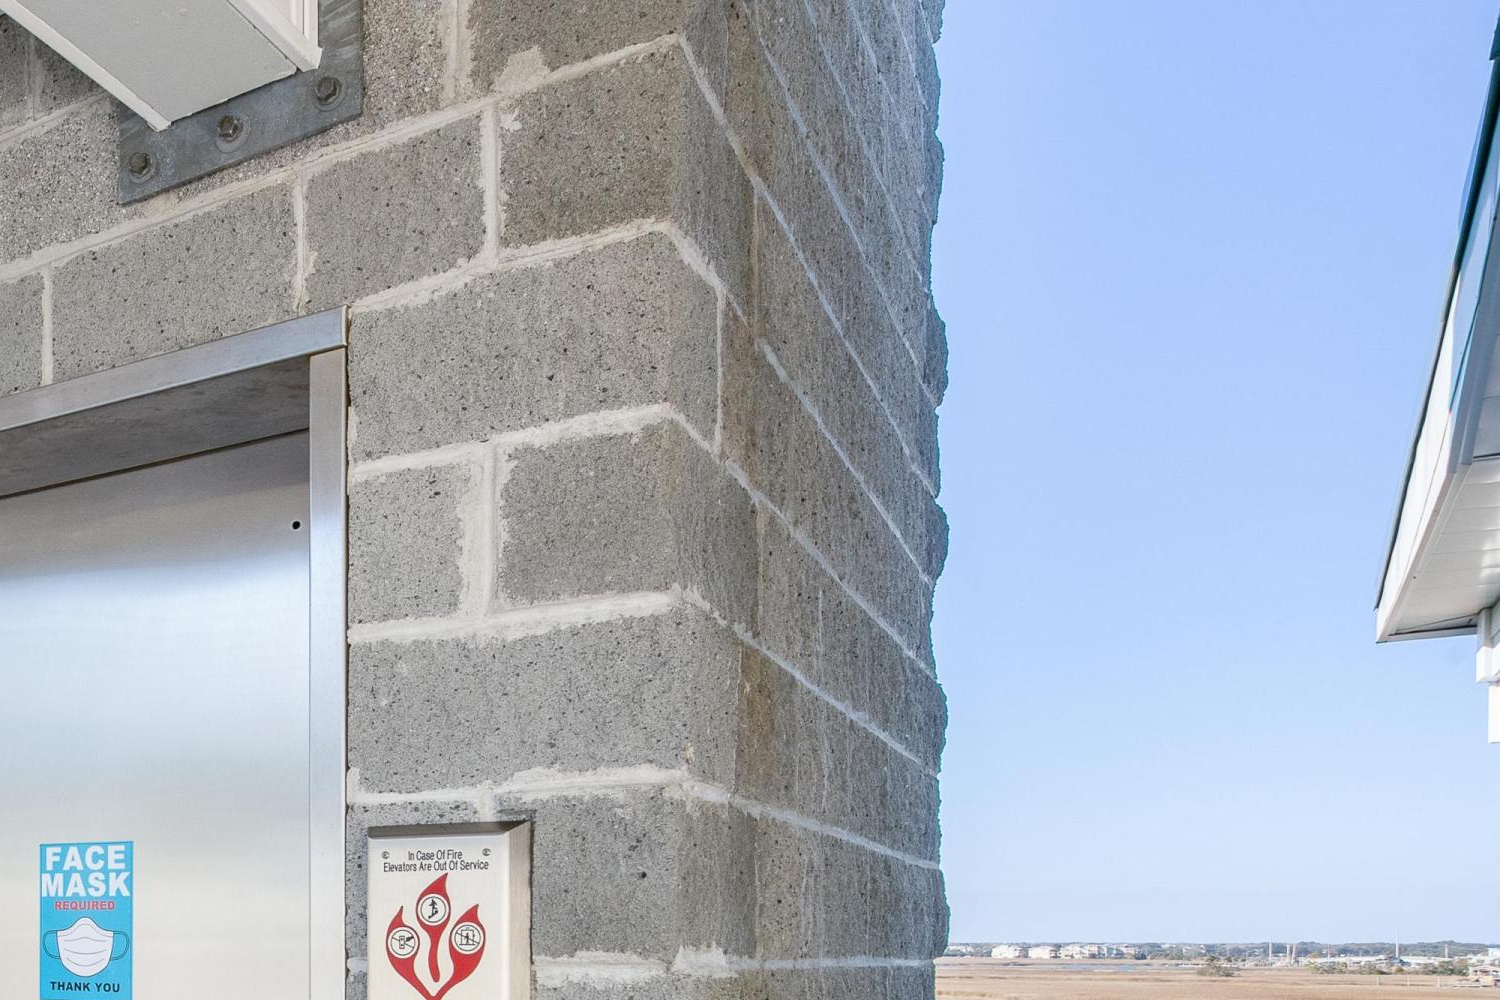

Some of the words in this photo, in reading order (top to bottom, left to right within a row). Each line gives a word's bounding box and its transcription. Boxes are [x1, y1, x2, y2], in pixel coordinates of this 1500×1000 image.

[45, 845, 126, 870] FACE
[408, 850, 415, 861] In
[416, 850, 435, 861] Case
[436, 849, 446, 860] Of
[446, 848, 463, 860] Fire
[383, 861, 417, 872] Elevators
[419, 861, 432, 871] Are
[433, 860, 447, 871] Out
[448, 860, 458, 871] Of
[460, 859, 489, 871] Service
[41, 872, 131, 898] MASK
[54, 900, 116, 911] REQUIRED
[51, 981, 91, 992] THANK
[95, 982, 120, 993] YOU
